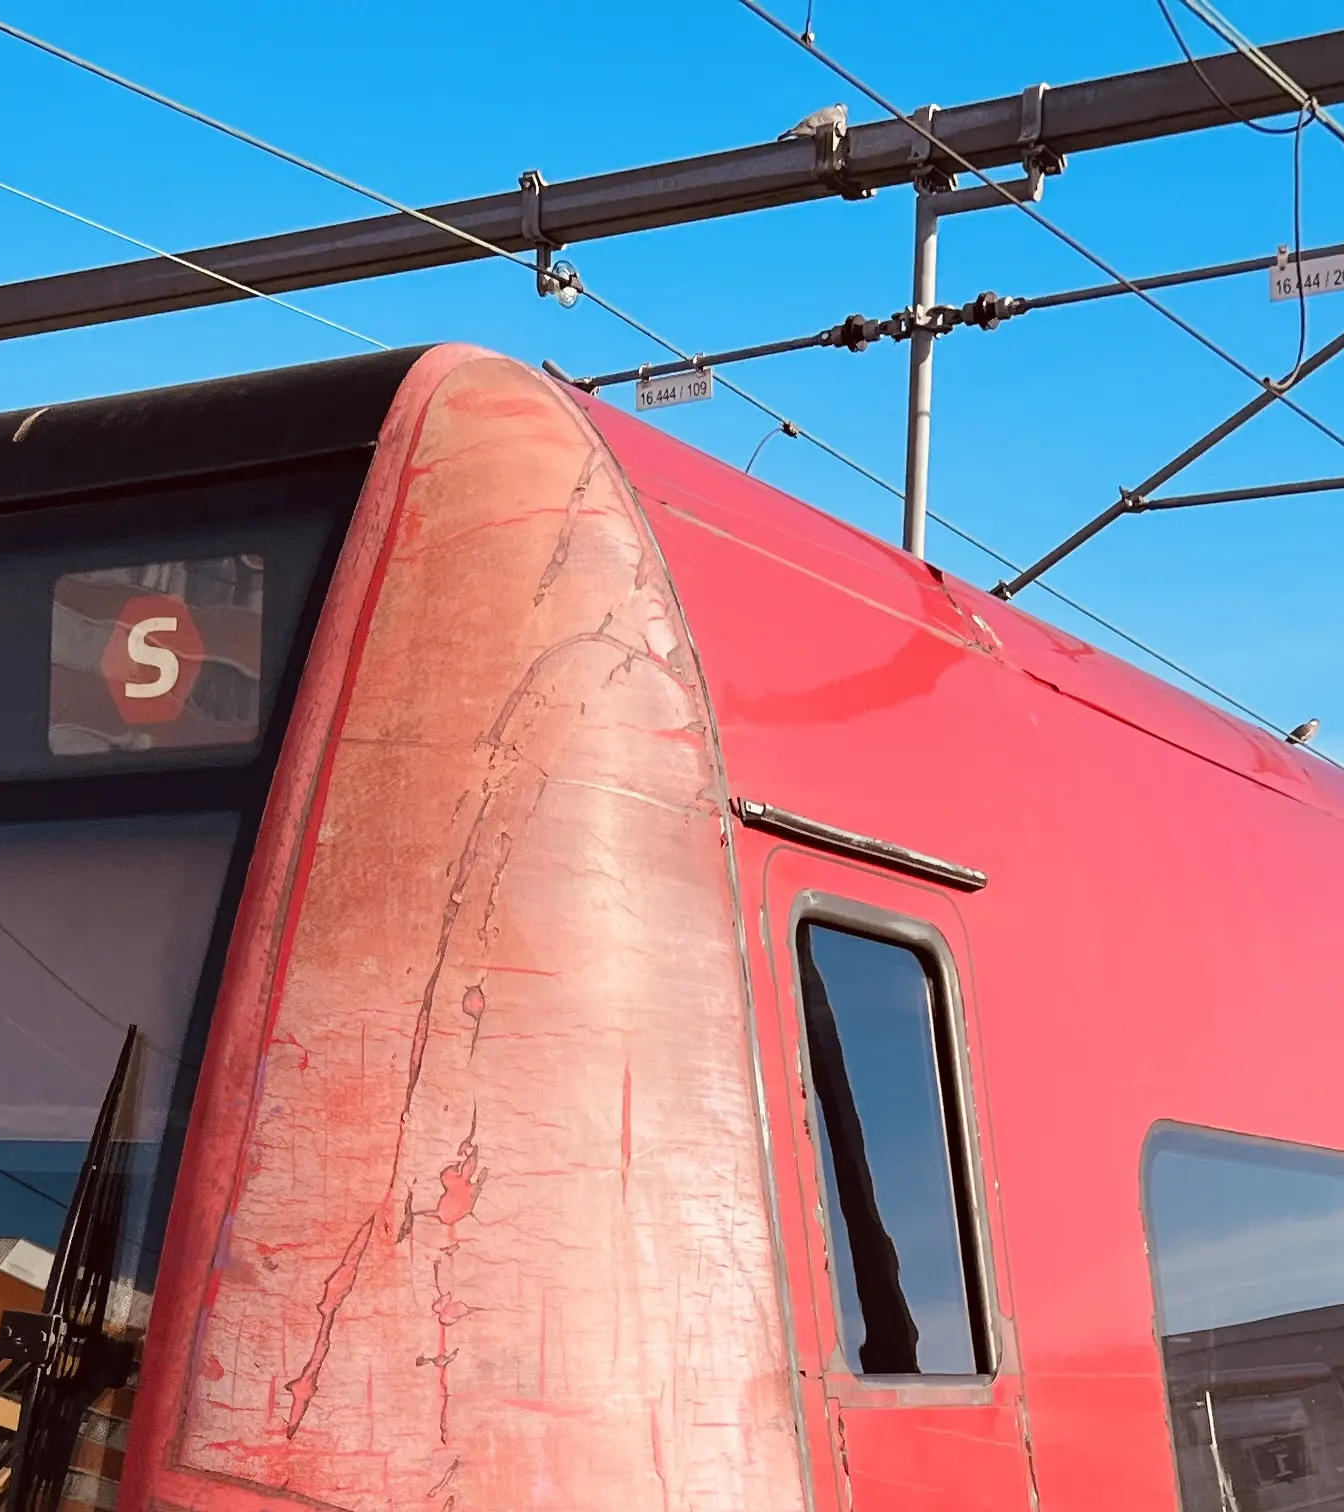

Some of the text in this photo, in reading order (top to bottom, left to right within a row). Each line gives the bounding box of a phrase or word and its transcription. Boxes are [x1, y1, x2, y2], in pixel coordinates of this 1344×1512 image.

[641, 387, 676, 406] 16.444
[687, 380, 707, 397] 109
[125, 616, 179, 698] S
